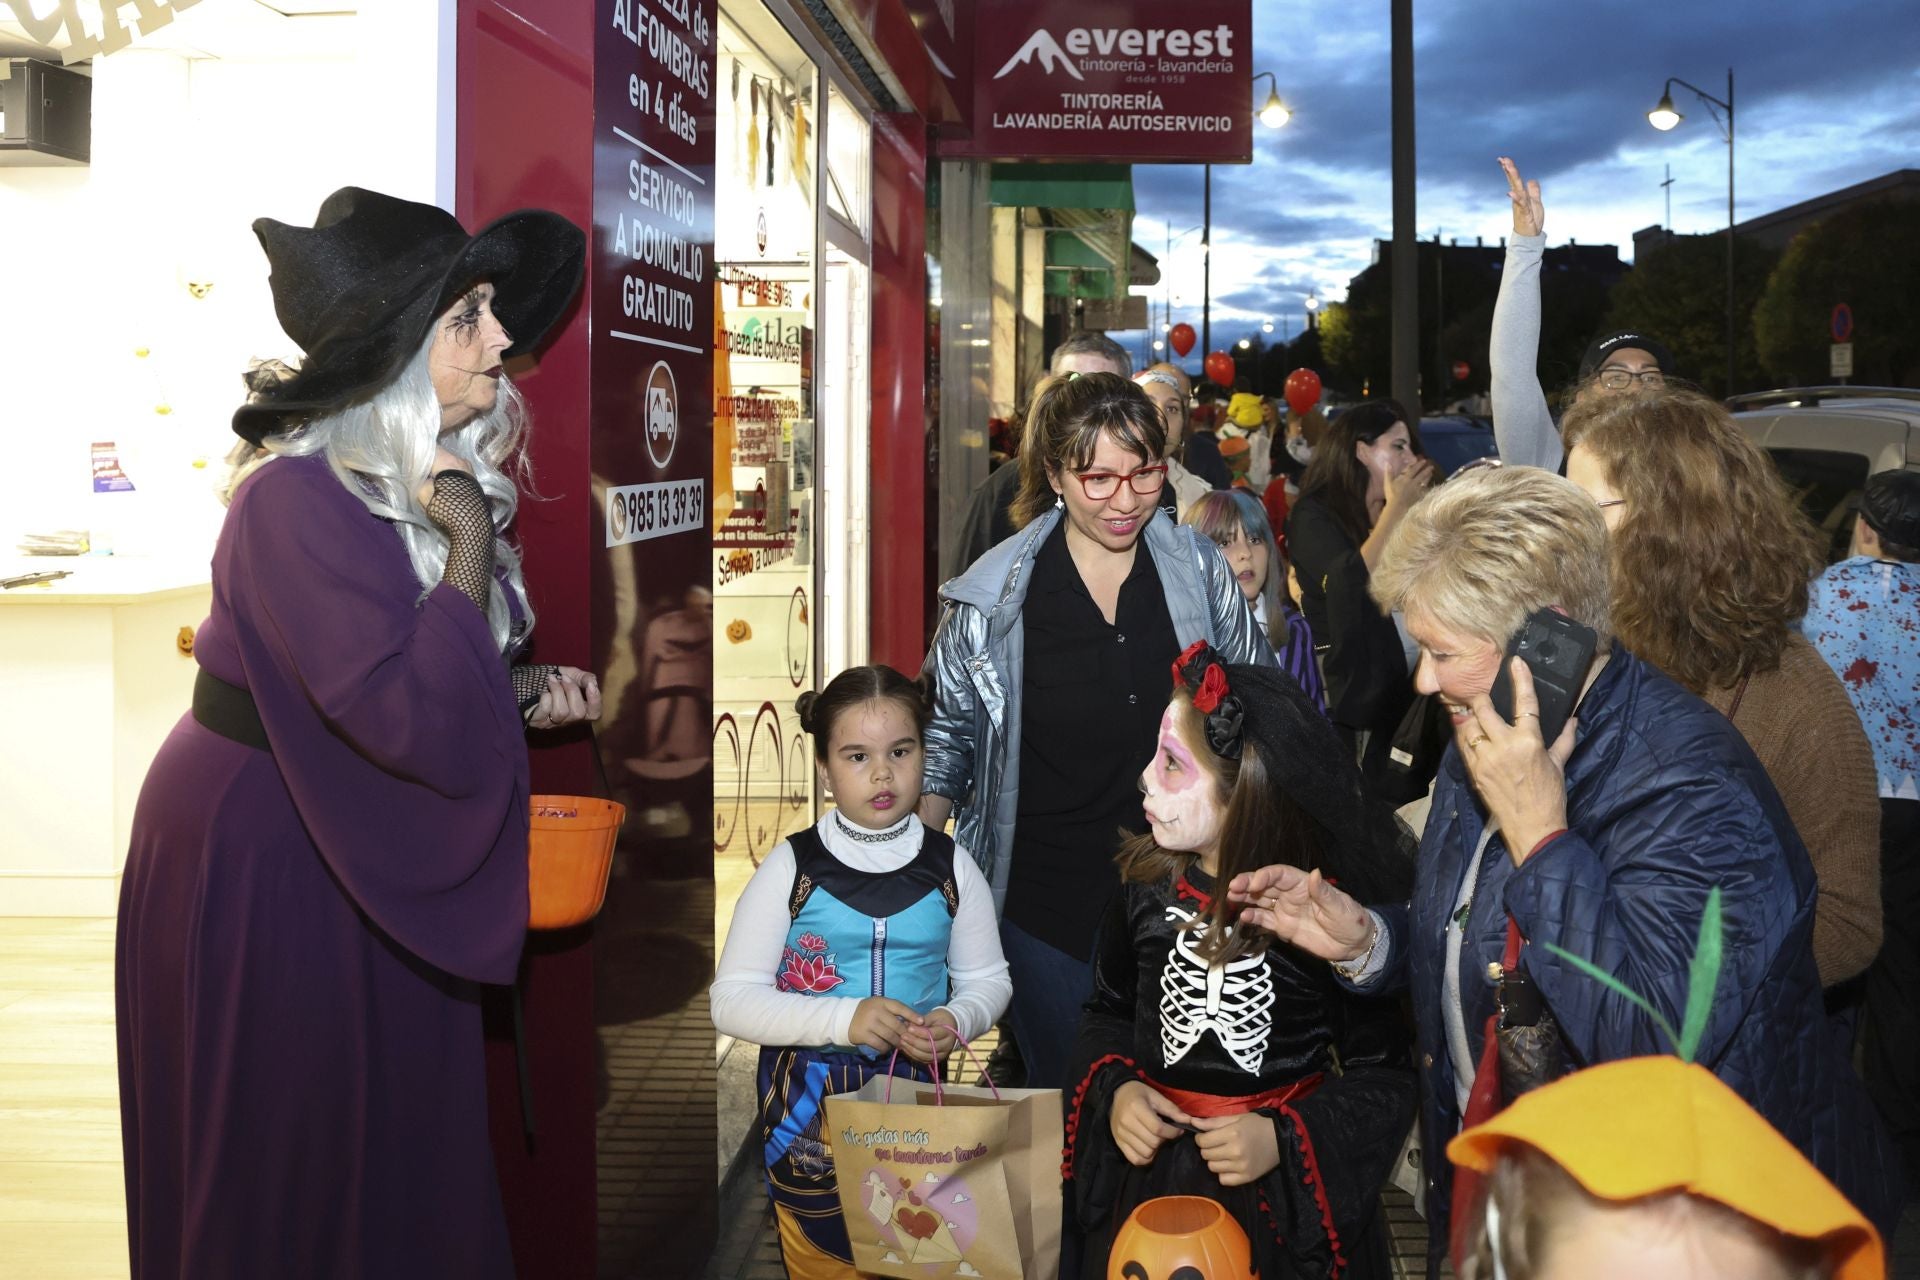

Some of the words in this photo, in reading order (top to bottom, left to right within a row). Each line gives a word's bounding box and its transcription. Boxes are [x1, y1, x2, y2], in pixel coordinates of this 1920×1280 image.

[694, 1, 709, 46] de
[1065, 25, 1233, 56] everest
[612, 0, 709, 99] ALFOMBRAS
[1080, 57, 1146, 72] tintorería
[1157, 57, 1233, 73] lavandería
[1126, 75, 1157, 84] desde
[1161, 75, 1186, 84] 1958
[629, 73, 649, 115] en
[654, 81, 664, 124] 4
[669, 91, 697, 146] días
[1061, 90, 1164, 110] TINTORERÍA
[993, 111, 1103, 130] LAVANDERÍA
[1108, 116, 1232, 132] AUTOSERVICIO
[628, 159, 695, 228] SERVICIO
[614, 212, 628, 256] A
[632, 218, 703, 283] DOMICILIO
[622, 274, 694, 332] GRATUITO
[713, 320, 751, 360] impieza
[753, 331, 763, 357] de
[629, 490, 655, 534] 985
[658, 488, 670, 528] 13
[673, 487, 687, 526] 39
[689, 485, 702, 522] 39
[718, 547, 754, 586] Servicio
[756, 549, 762, 571] a
[863, 1125, 899, 1149] gustas
[902, 1128, 930, 1146] más
